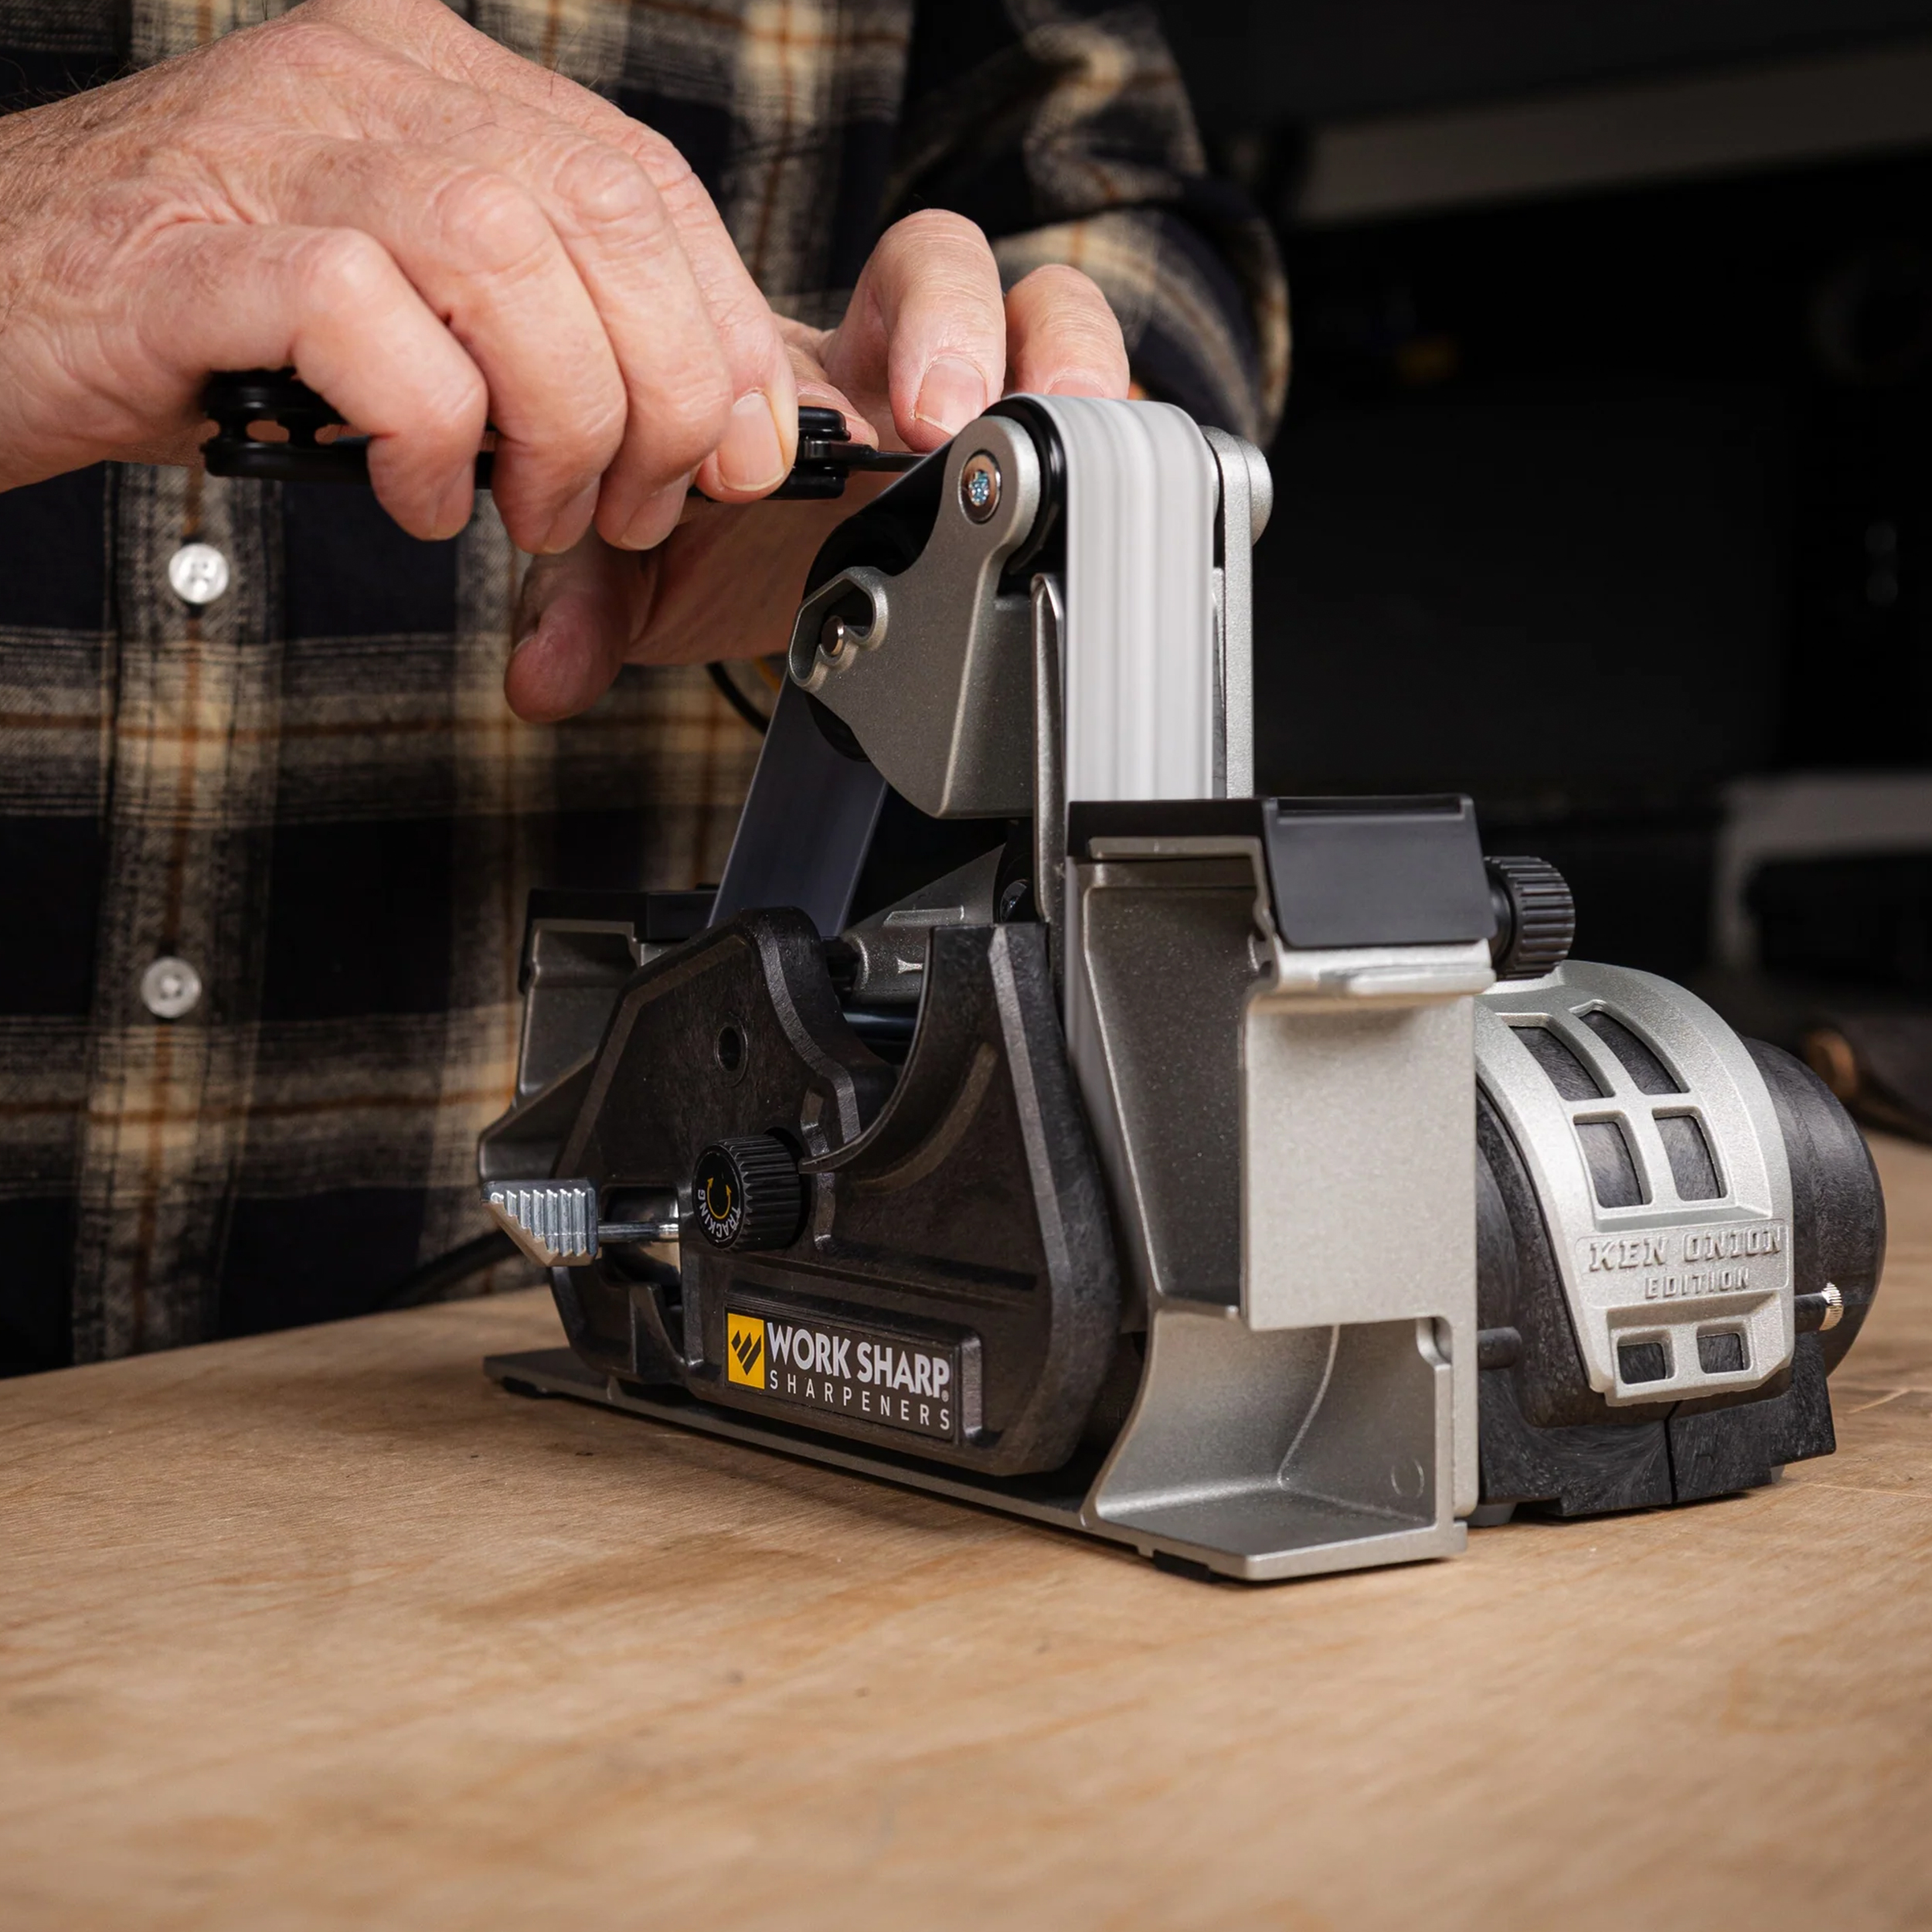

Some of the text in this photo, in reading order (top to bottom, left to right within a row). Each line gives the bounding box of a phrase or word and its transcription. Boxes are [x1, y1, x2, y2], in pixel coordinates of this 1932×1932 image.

[697, 1189, 741, 1237] TRACKING
[1589, 1224, 1781, 1272] KEN ONION
[1645, 1267, 1750, 1299] EDITION
[767, 1322, 851, 1379] WORK
[770, 1370, 951, 1430] SHARPENERS
